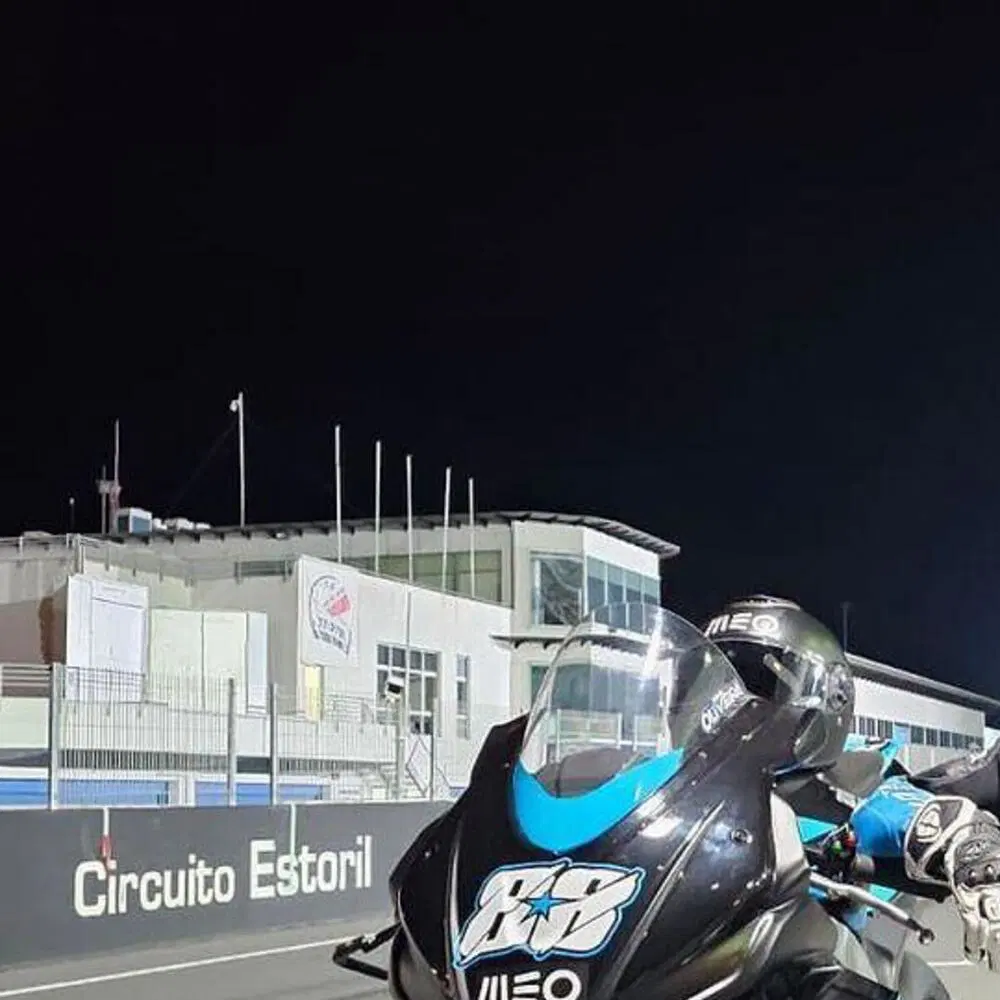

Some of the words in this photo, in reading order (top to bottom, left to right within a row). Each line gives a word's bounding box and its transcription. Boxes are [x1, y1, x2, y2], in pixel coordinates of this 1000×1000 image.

[703, 612, 779, 637] MEO
[74, 853, 236, 918] Circuito
[249, 834, 373, 900] Estoril
[458, 860, 642, 966] 88
